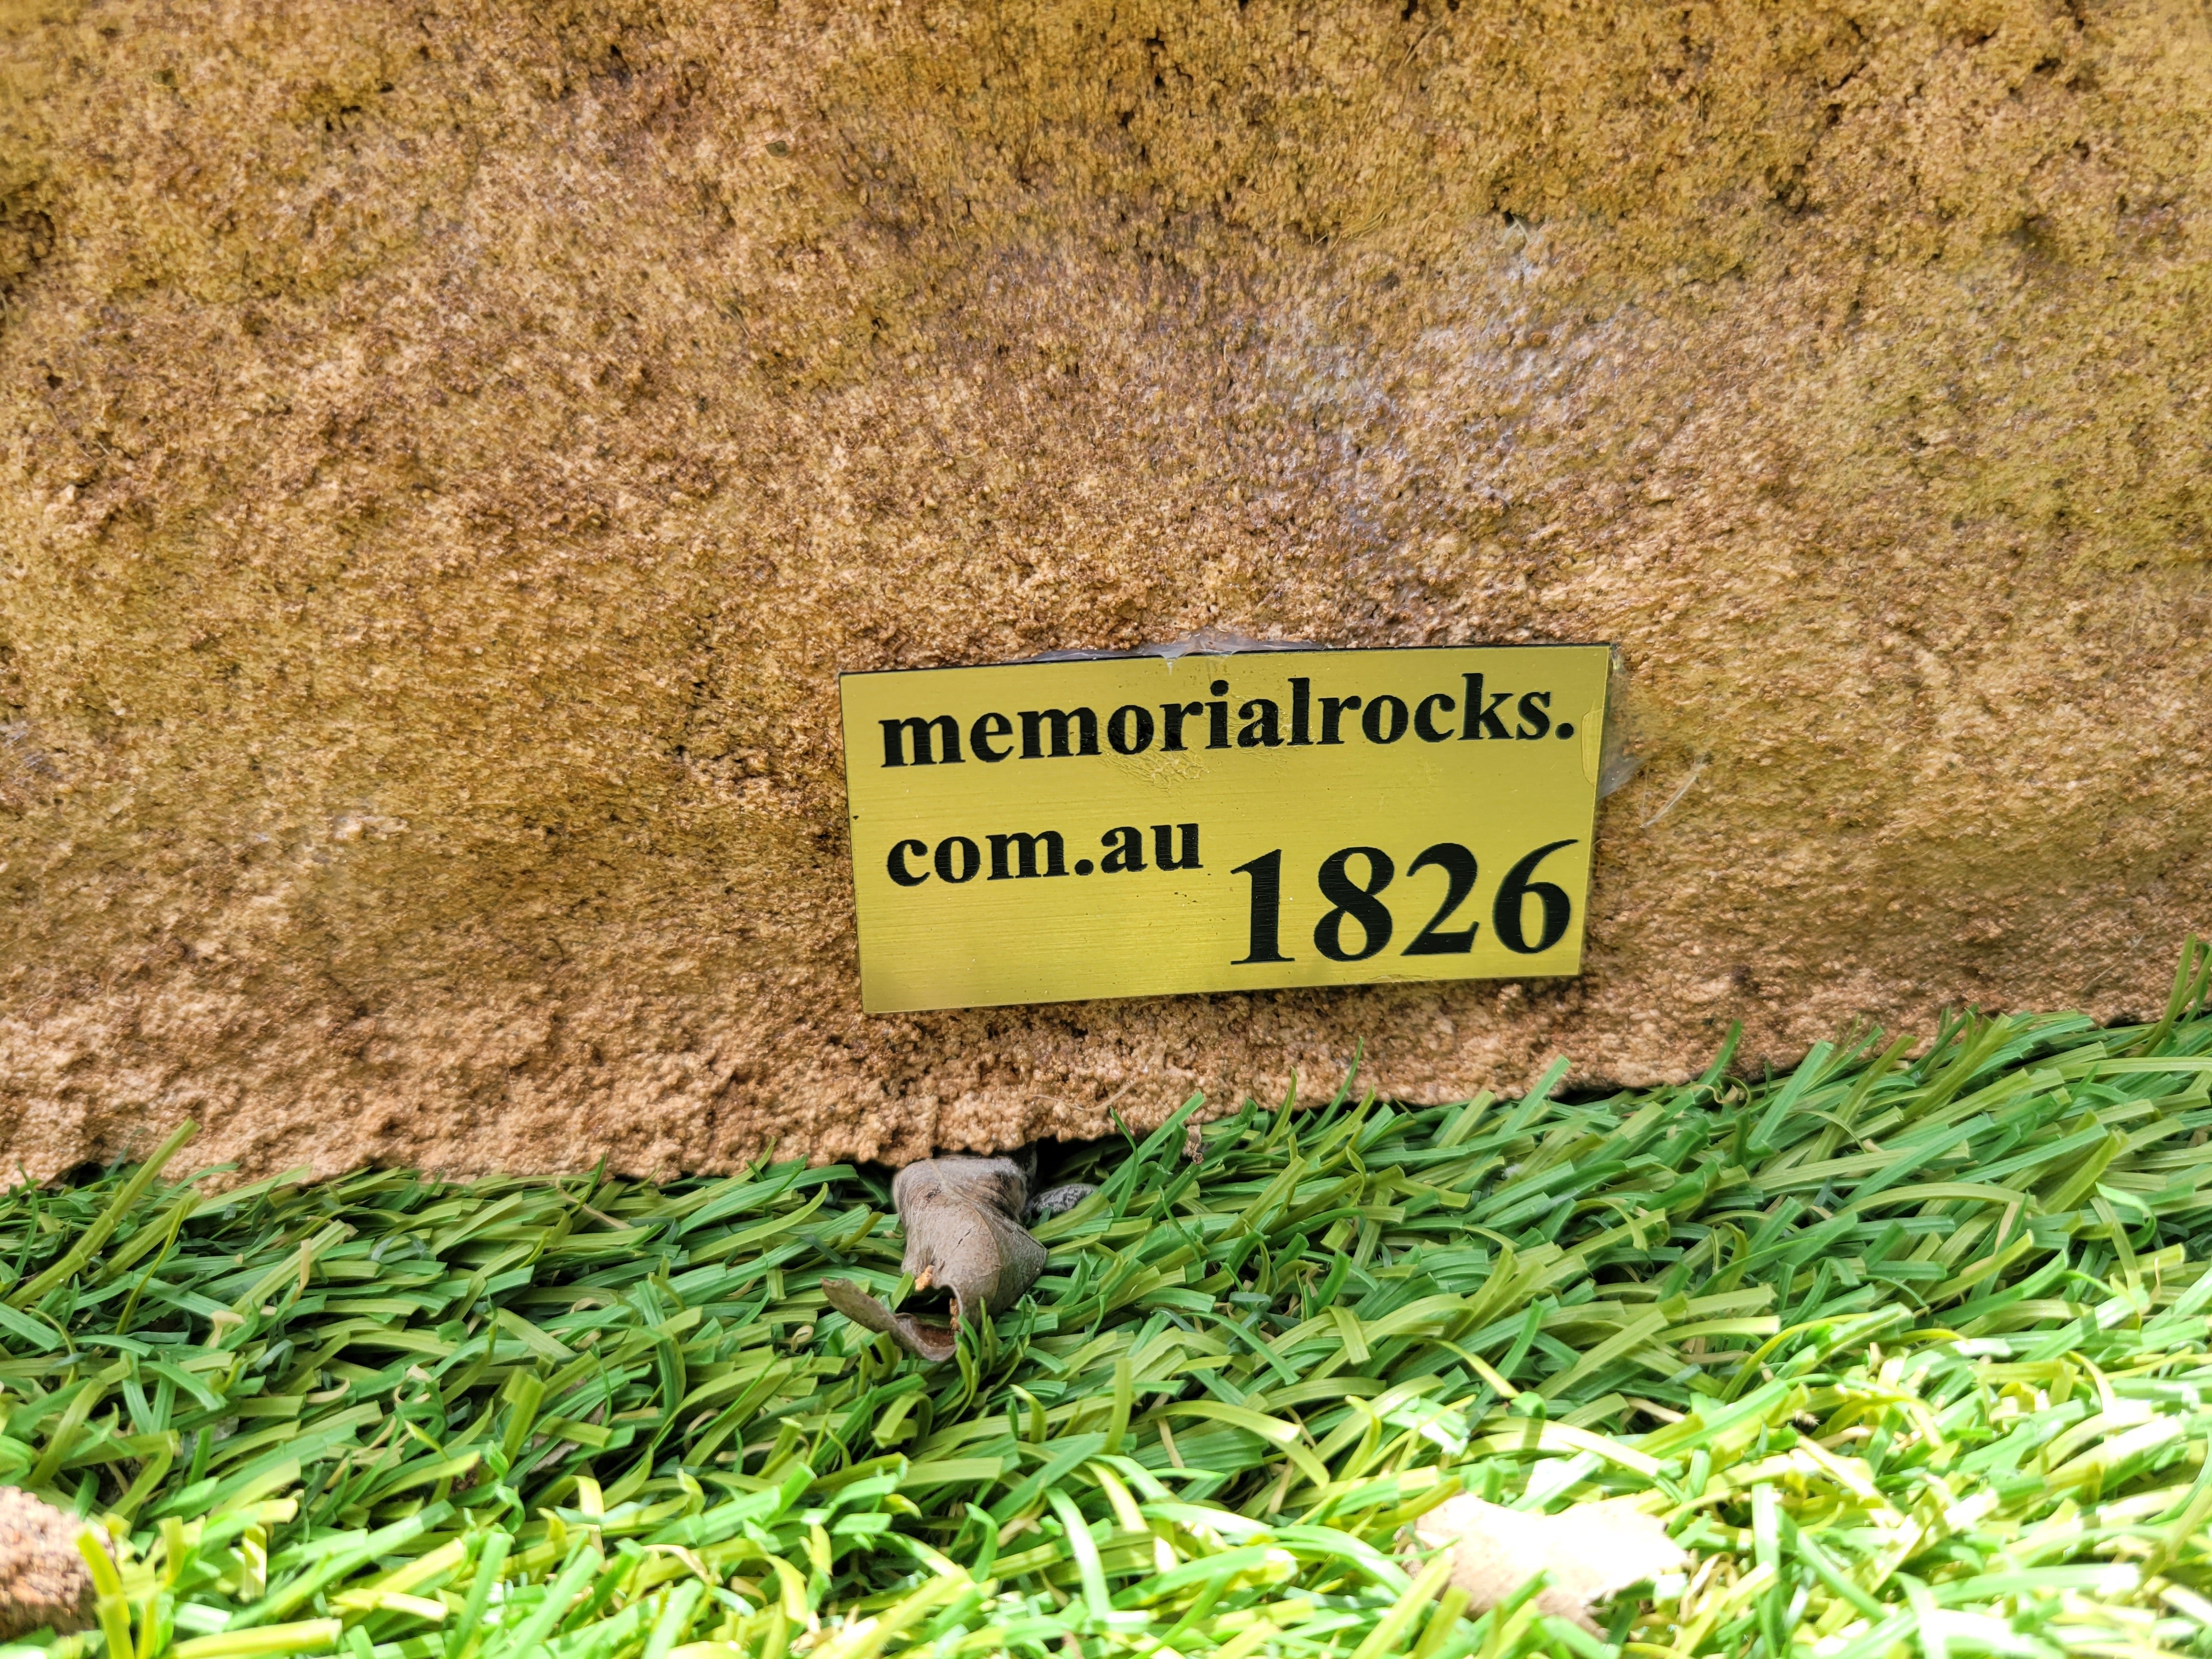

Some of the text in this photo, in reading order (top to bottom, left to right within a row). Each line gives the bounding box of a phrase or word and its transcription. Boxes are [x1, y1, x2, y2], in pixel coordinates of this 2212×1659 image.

[878, 672, 1575, 768] memorialrocks.
[886, 822, 1204, 887] com.au
[1229, 838, 1579, 966] 1826
